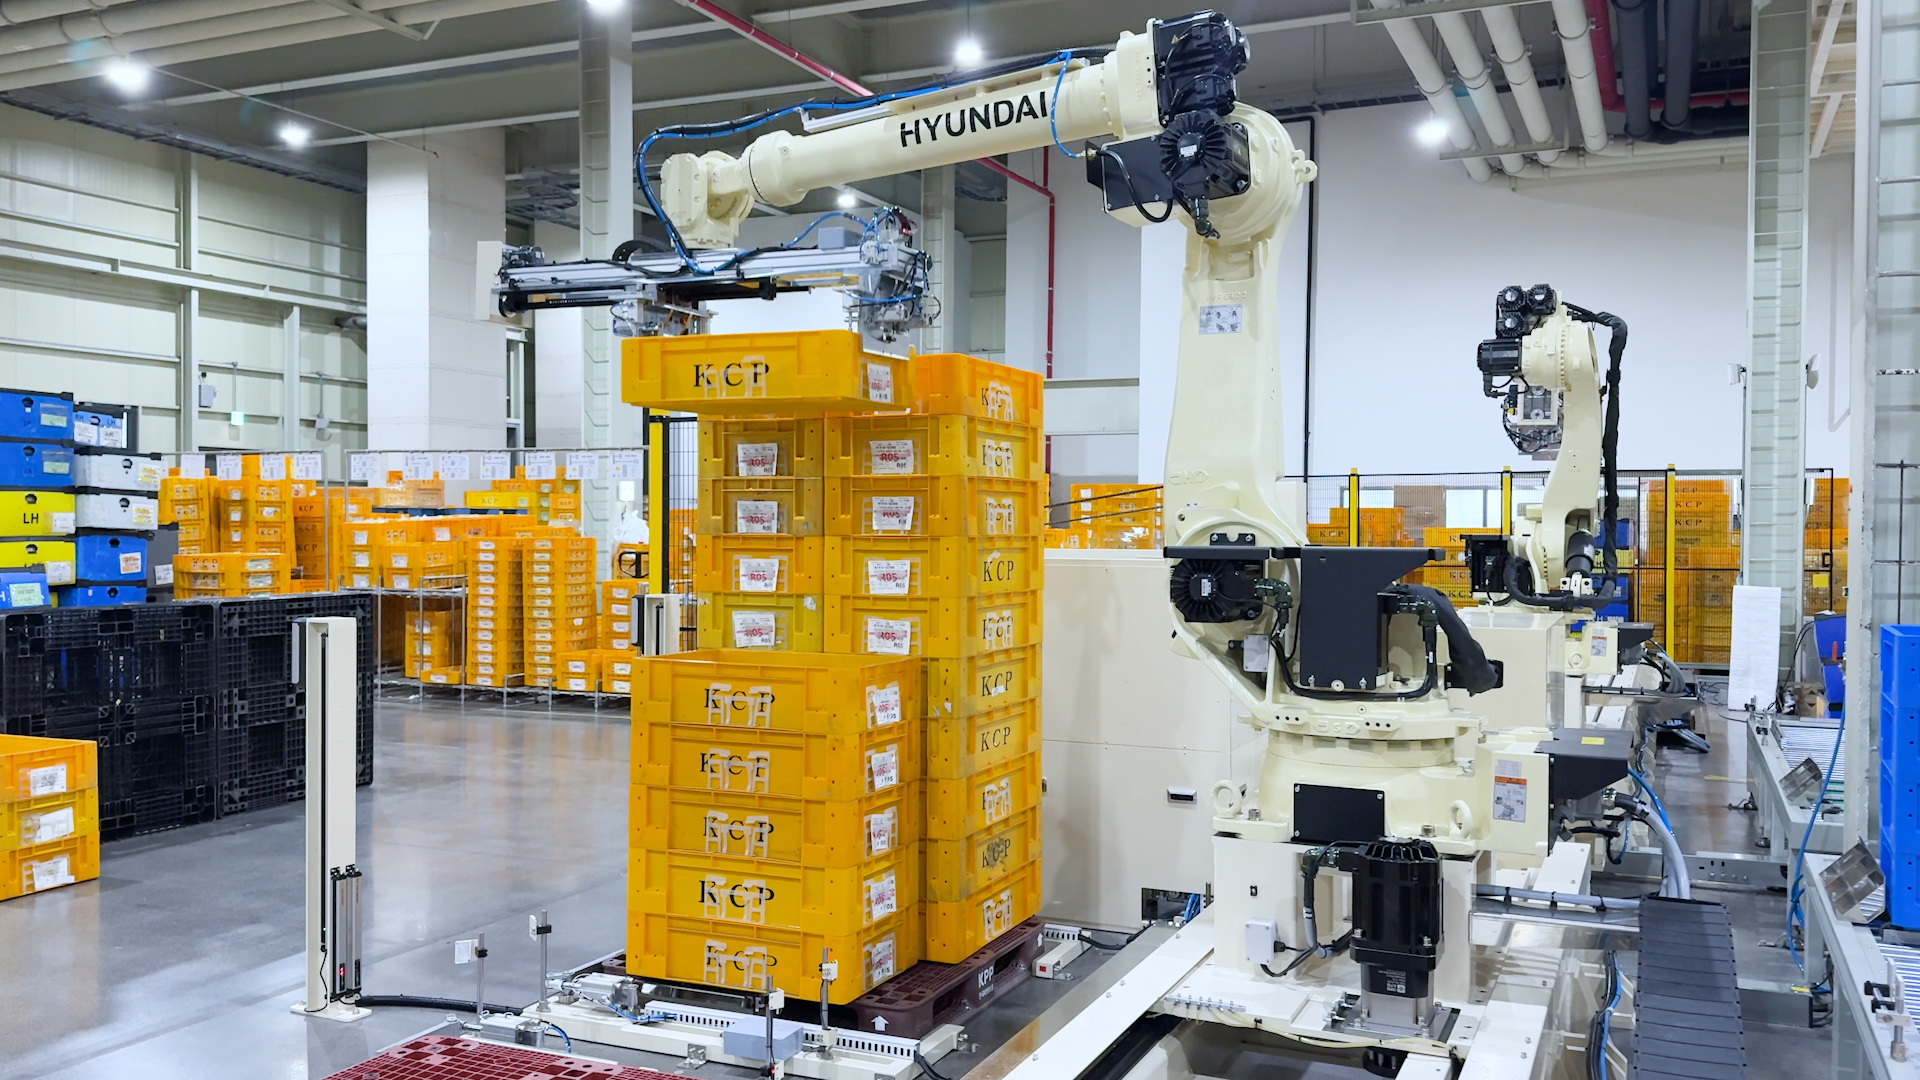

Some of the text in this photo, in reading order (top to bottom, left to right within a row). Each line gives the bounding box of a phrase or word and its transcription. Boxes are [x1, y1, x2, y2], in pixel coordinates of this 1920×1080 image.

[900, 91, 1048, 147] HYUNDAI
[693, 362, 769, 387] KCP
[880, 453, 899, 462] R05
[23, 513, 39, 524] LH
[297, 544, 318, 552] KCP
[750, 573, 767, 582] R05
[982, 560, 1014, 582] KCP
[704, 688, 775, 713] KCP
[981, 726, 1011, 752] KCP
[703, 816, 774, 842] KCP
[698, 880, 775, 908] KCP
[978, 965, 994, 988] KPP
